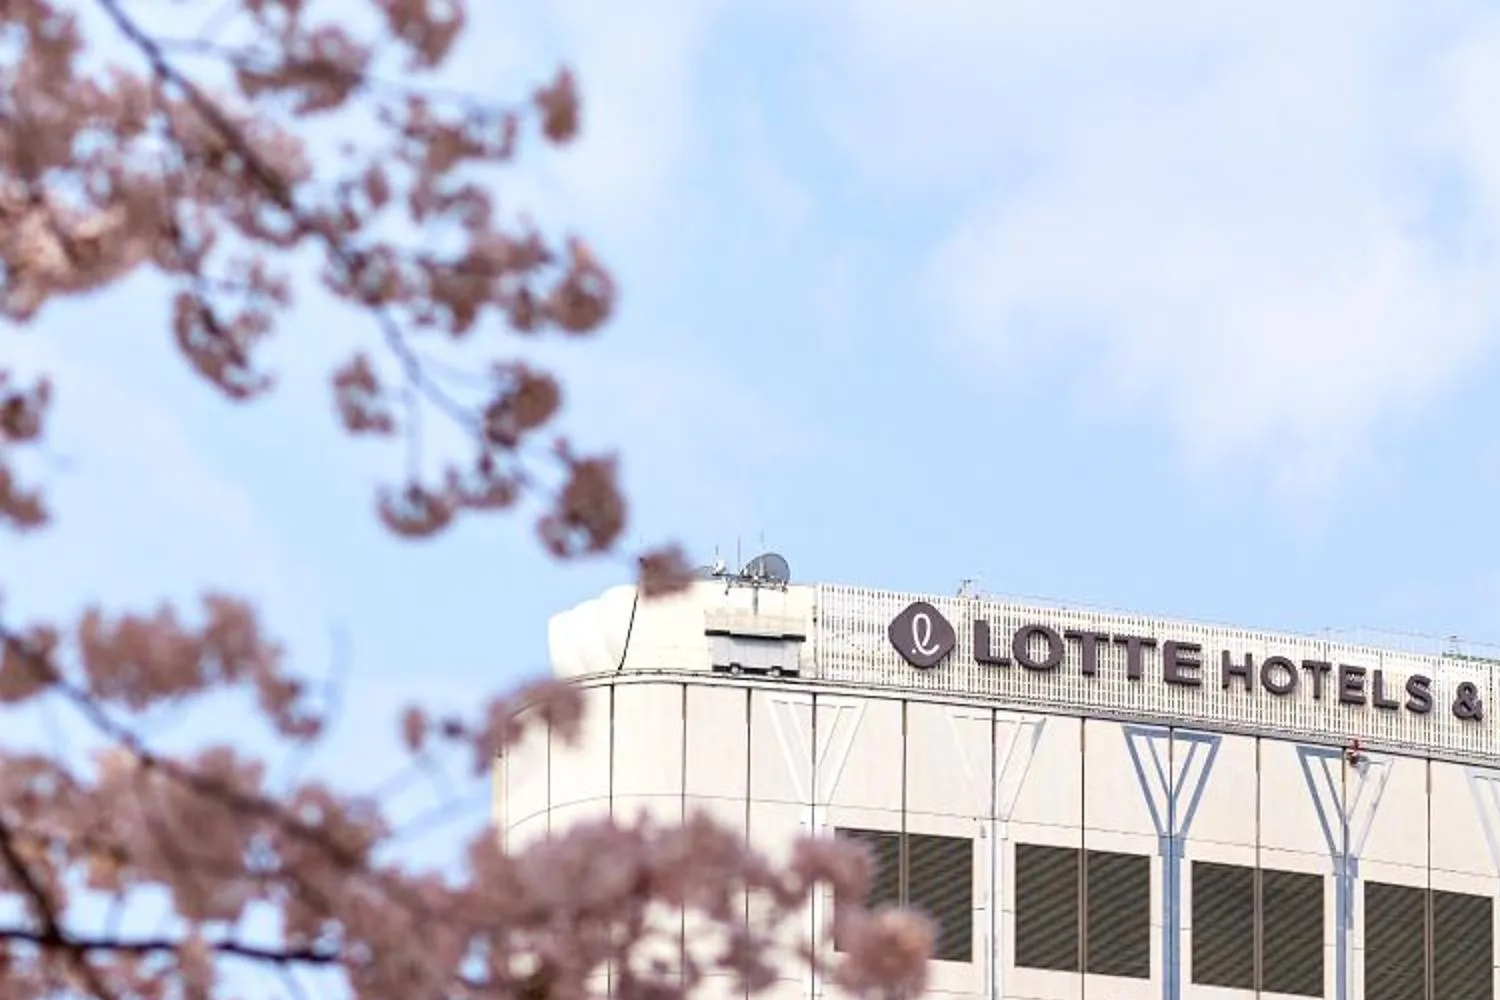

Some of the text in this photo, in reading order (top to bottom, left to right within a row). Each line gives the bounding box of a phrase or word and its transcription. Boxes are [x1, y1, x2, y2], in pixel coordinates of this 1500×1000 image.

[973, 619, 1201, 687] LOTTE
[1221, 649, 1433, 714] HOTELS
[1452, 681, 1483, 721] &
